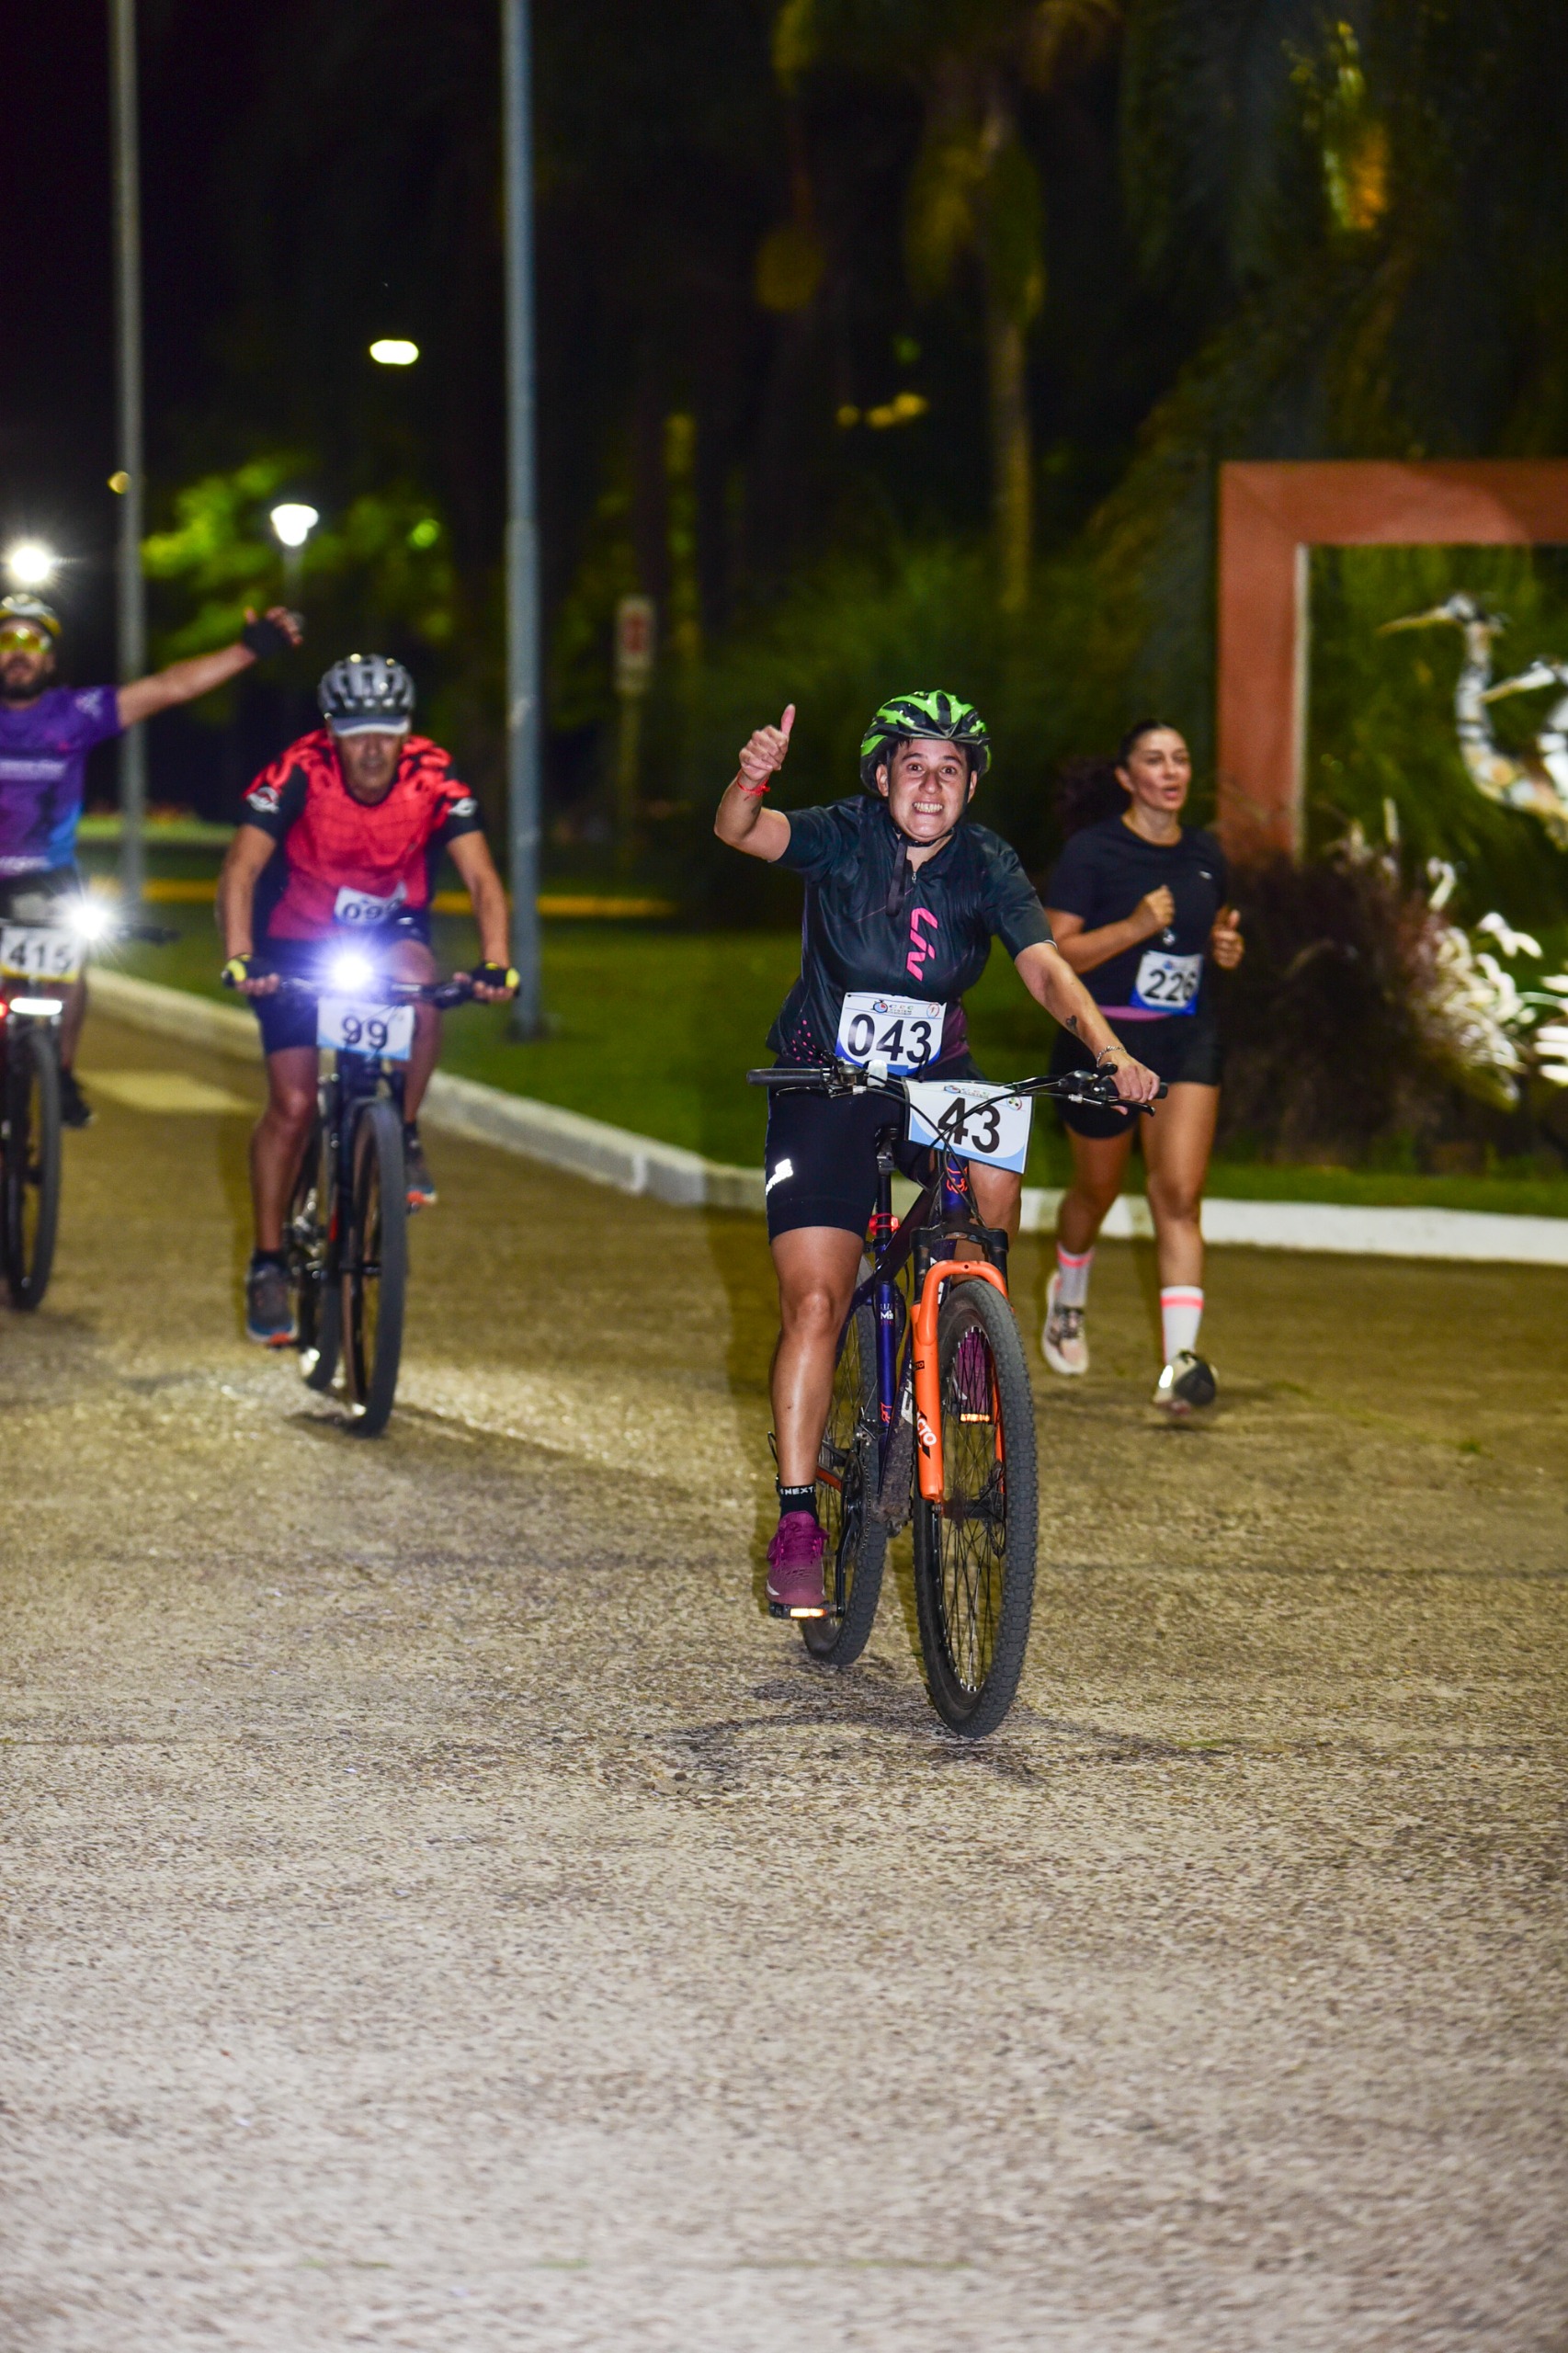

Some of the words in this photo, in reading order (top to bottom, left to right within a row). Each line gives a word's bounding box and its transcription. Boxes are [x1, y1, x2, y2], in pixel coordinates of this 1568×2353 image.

[341, 1016, 388, 1050] 99
[847, 1013, 932, 1063] 043
[937, 1097, 1001, 1154] 43
